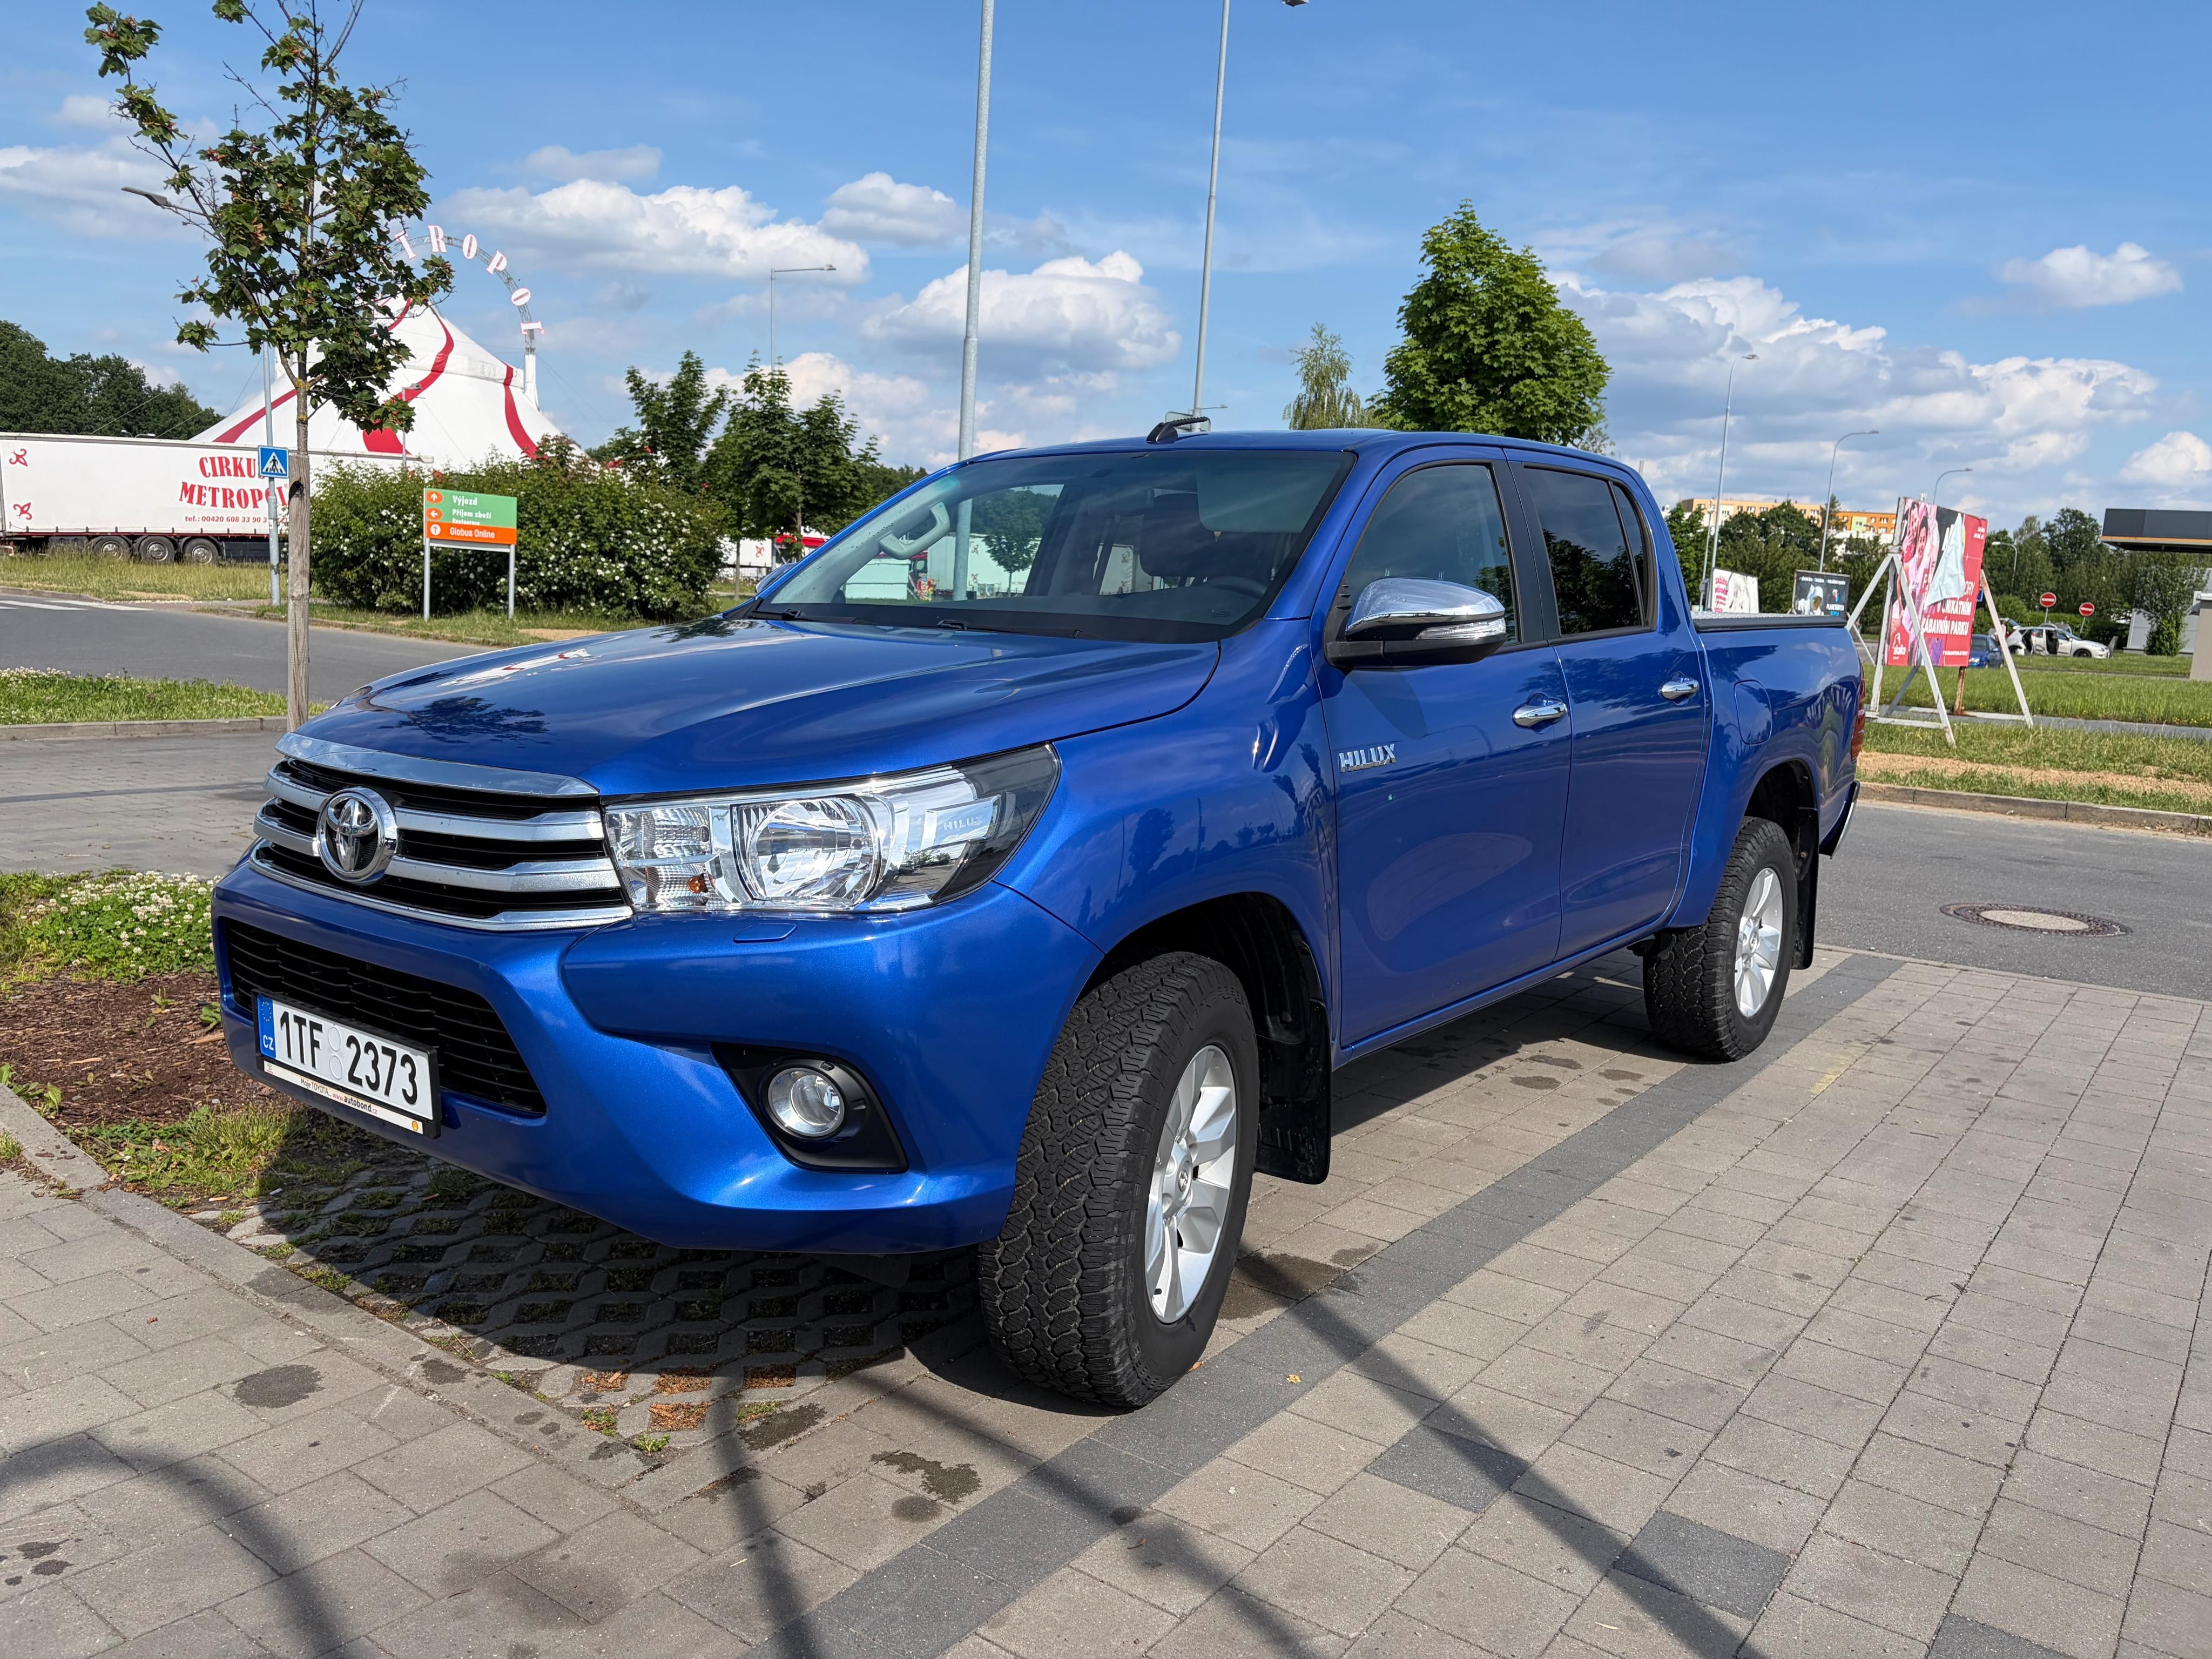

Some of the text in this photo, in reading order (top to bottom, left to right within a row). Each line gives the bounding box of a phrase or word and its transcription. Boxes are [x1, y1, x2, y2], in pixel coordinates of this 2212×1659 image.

[199, 456, 265, 480] CIRKU
[453, 495, 477, 506] Výjezd
[453, 509, 492, 519] Příjem zboží
[450, 527, 495, 539] Globus Online
[1951, 620, 1970, 636] PARKU
[1339, 744, 1396, 773] HILUX
[943, 815, 984, 831] HILUX
[262, 1034, 274, 1051] CZ
[280, 1010, 418, 1105] 1TF 2373
[300, 1077, 312, 1090] Moje
